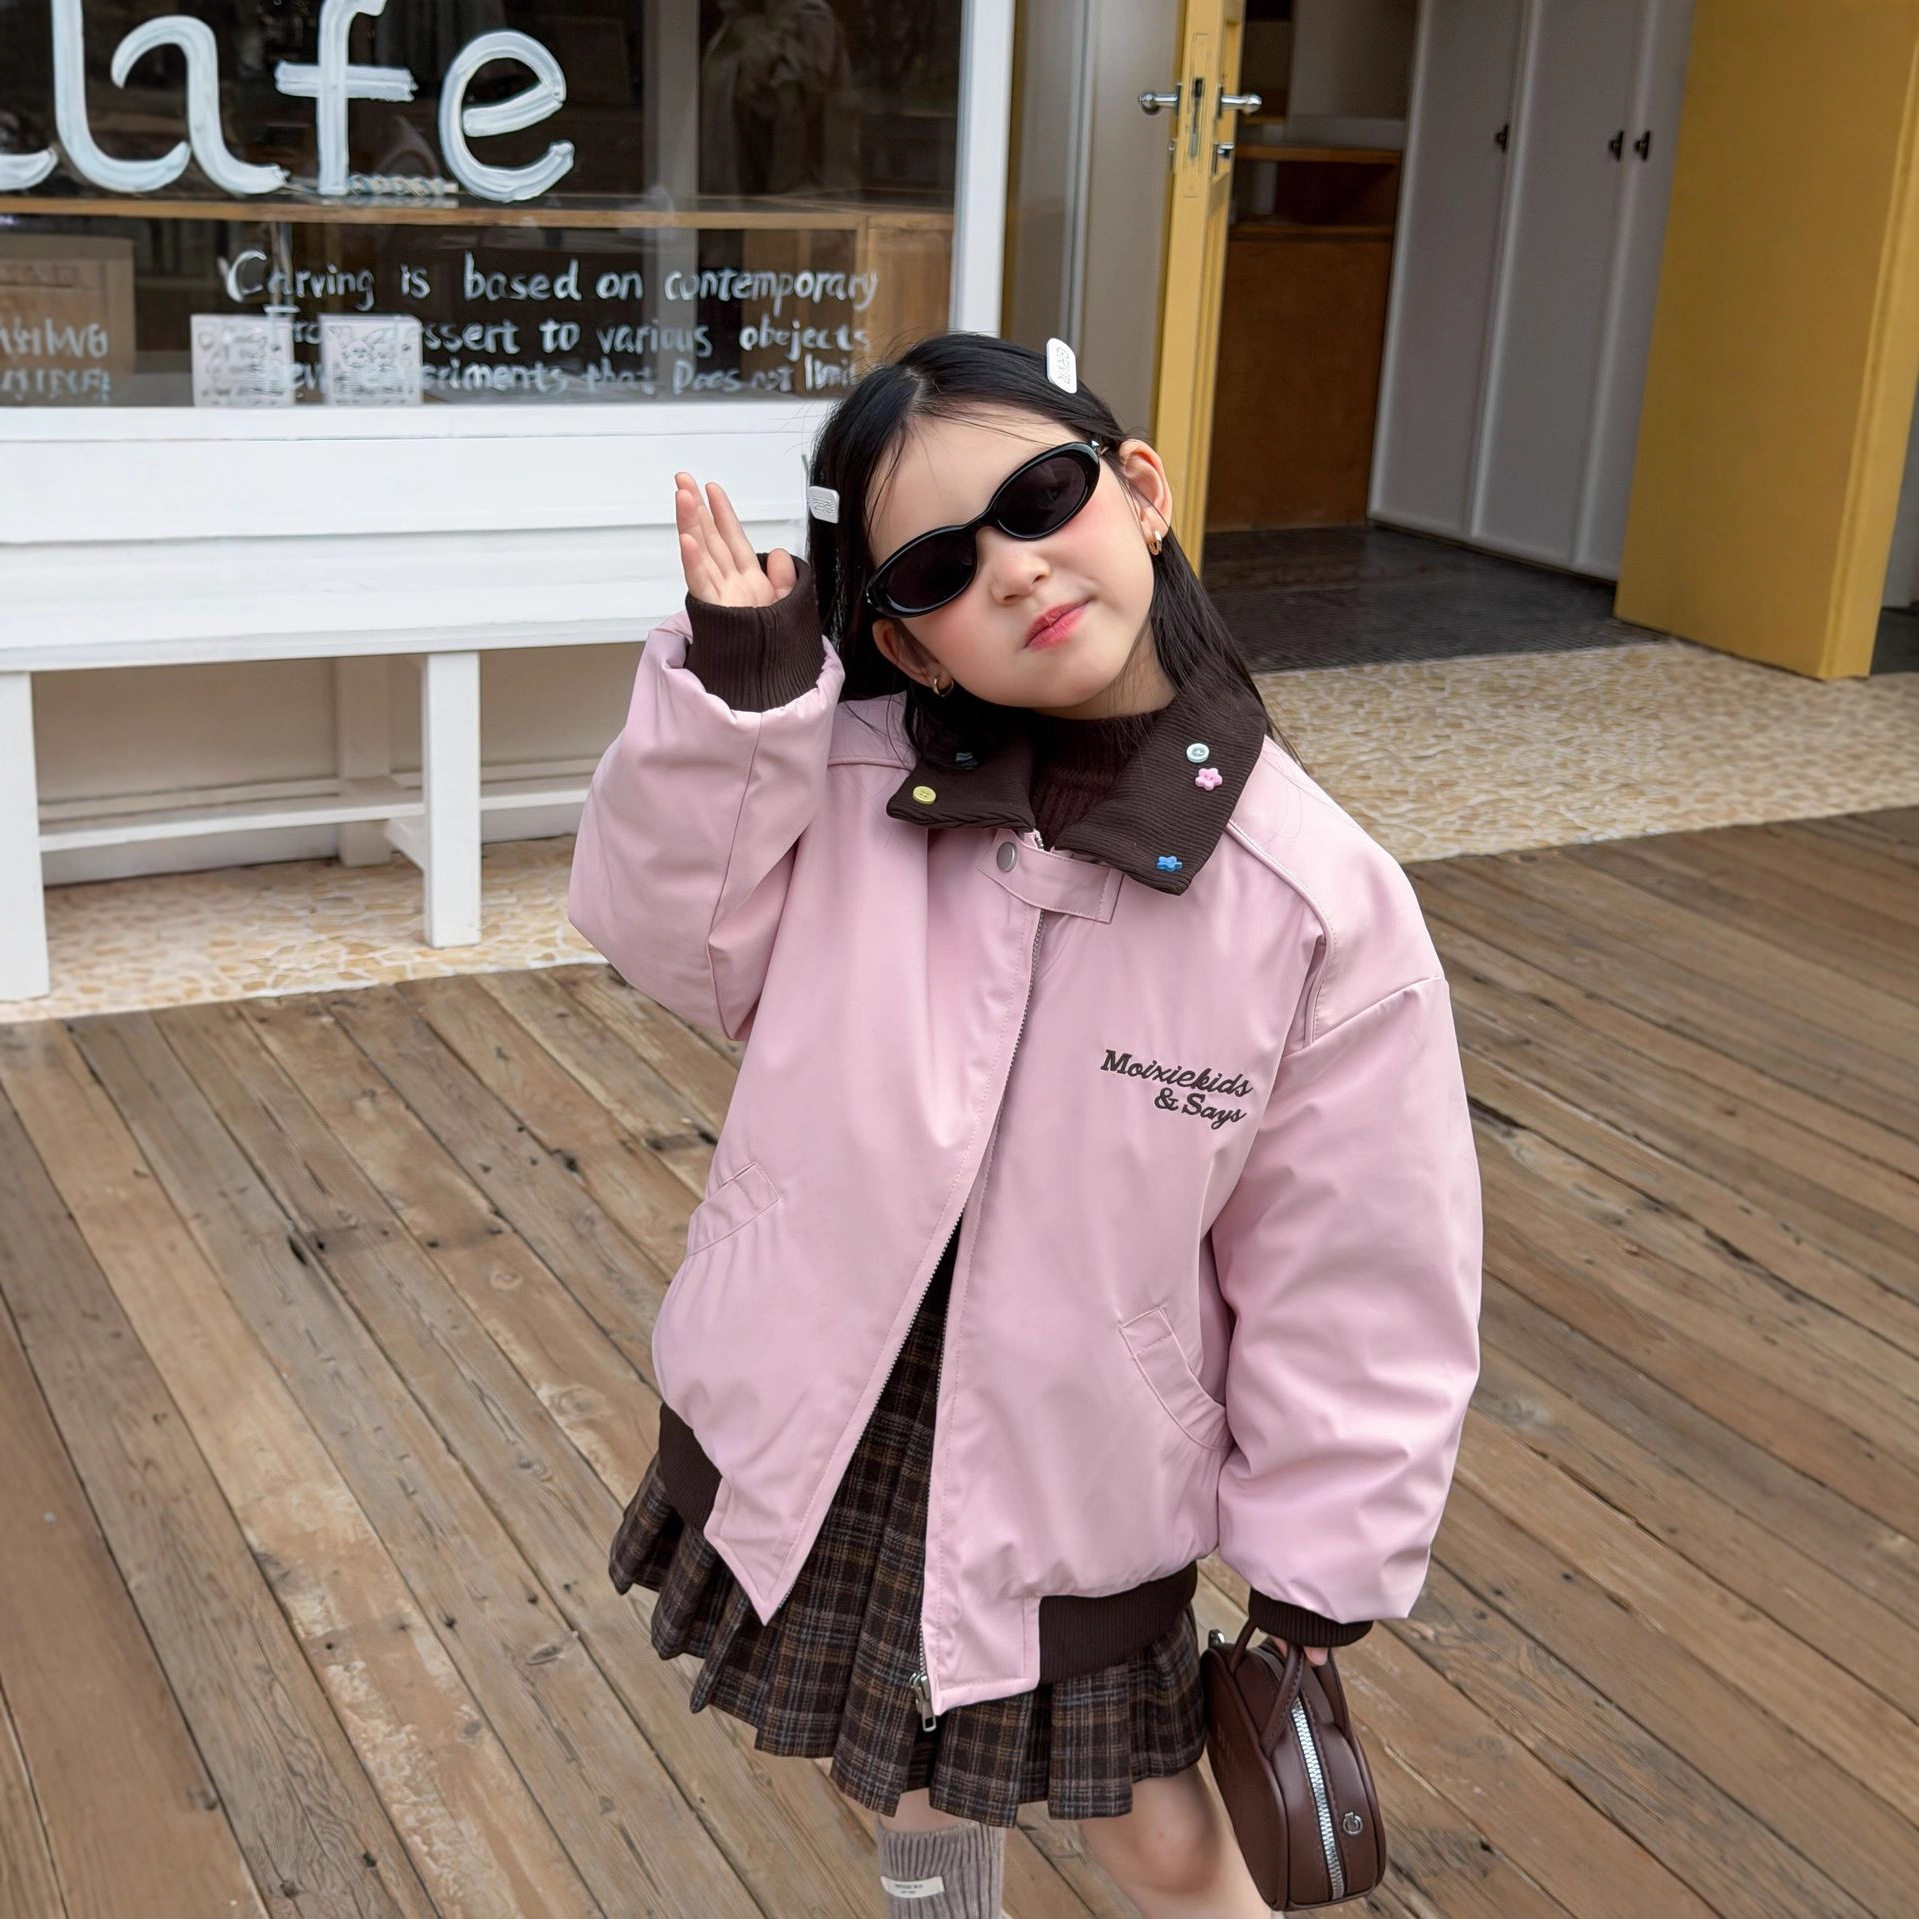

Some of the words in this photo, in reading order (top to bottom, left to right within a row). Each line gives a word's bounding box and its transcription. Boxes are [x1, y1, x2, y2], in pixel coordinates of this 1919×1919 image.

[218, 249, 374, 311] Carving
[400, 263, 430, 298] is
[463, 251, 582, 301] based
[596, 270, 644, 301] on
[664, 265, 878, 318] contemporary
[539, 320, 581, 353] to
[596, 319, 713, 358] various
[1154, 1087, 1179, 1111] &
[1181, 1092, 1247, 1130] Says
